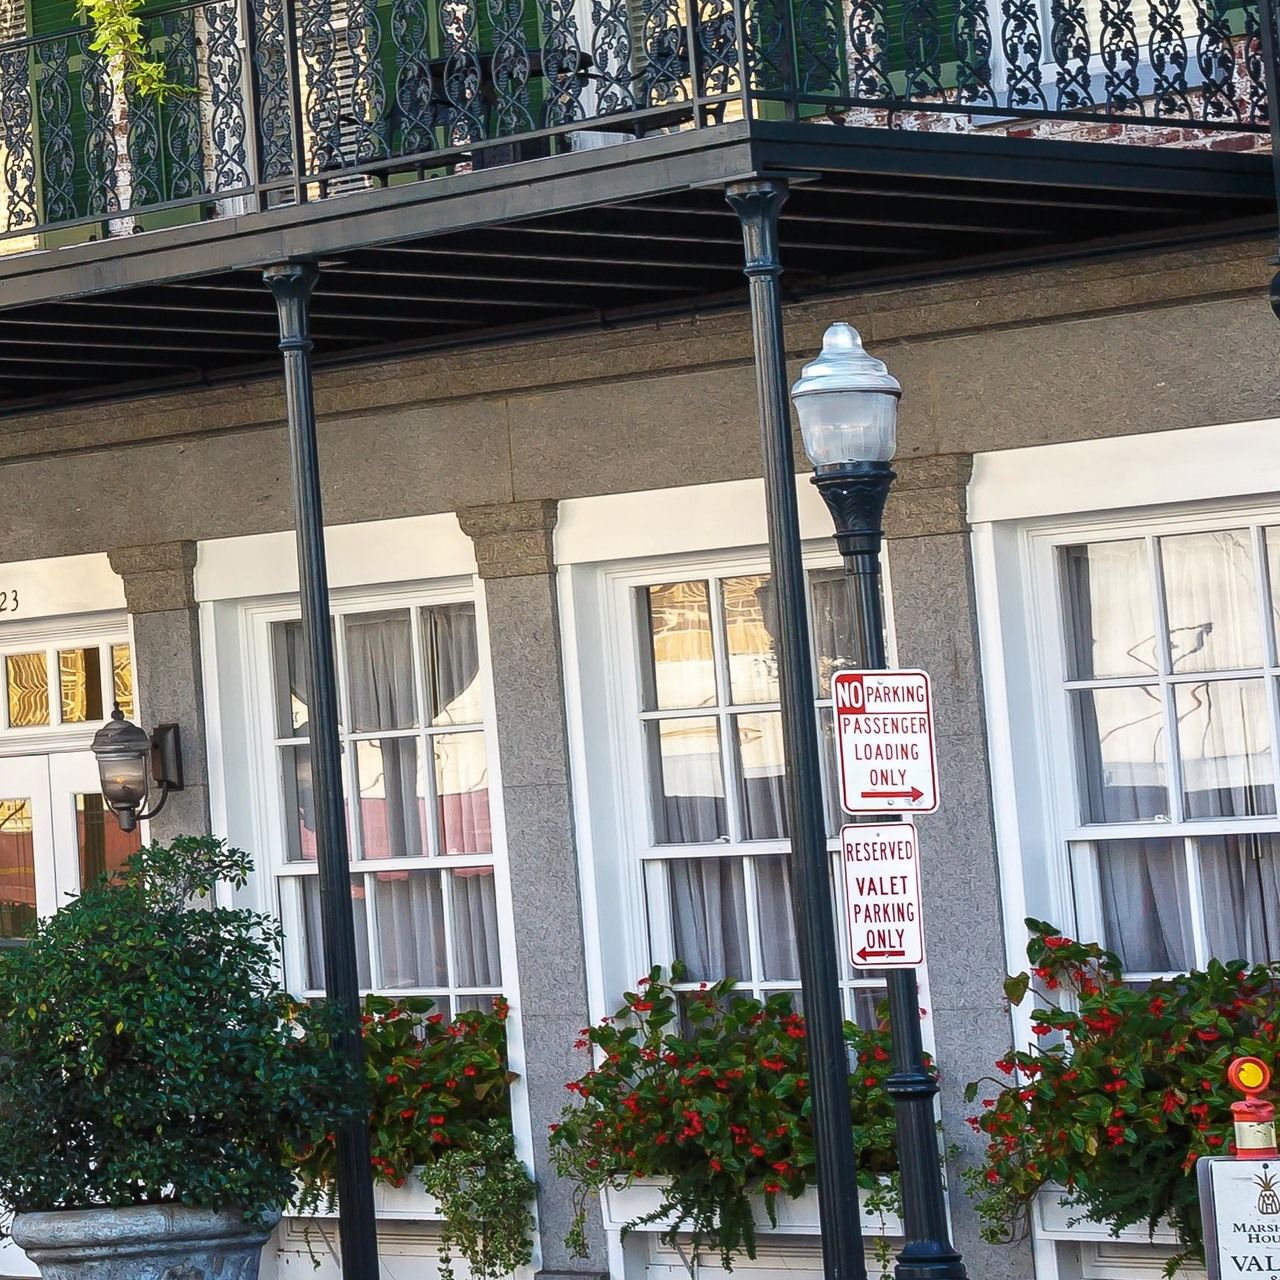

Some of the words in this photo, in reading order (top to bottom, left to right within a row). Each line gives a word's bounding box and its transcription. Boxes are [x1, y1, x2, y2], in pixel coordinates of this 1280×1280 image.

[837, 681, 863, 708] NO
[866, 685, 925, 703] PARKING
[843, 717, 927, 734] PASSENGER
[855, 744, 919, 760] LOADING
[870, 769, 907, 786] ONLY
[847, 841, 913, 862] RESERVED
[856, 876, 908, 896] VALET
[854, 902, 914, 923] PARKING
[867, 929, 905, 948] ONLY
